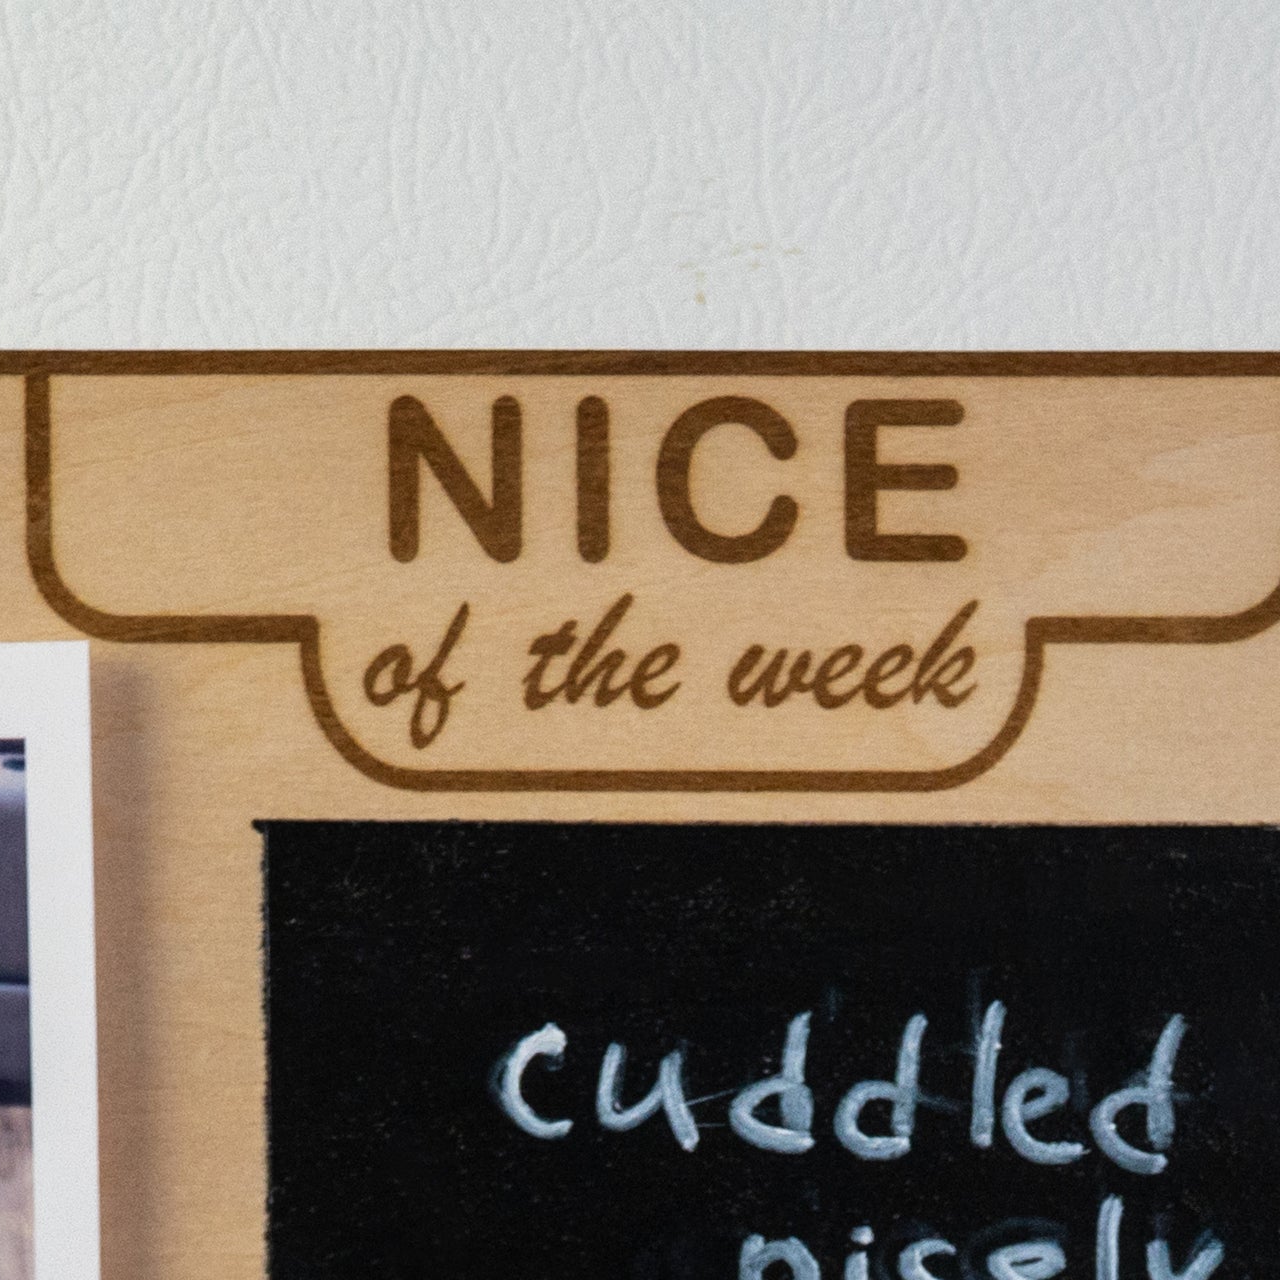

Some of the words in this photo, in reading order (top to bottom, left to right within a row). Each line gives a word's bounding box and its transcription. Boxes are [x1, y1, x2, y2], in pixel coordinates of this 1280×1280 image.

[387, 394, 969, 565] NICE
[363, 602, 470, 750] of
[522, 593, 682, 711] the
[727, 600, 980, 711] week
[496, 1000, 1186, 1176] cuddled
